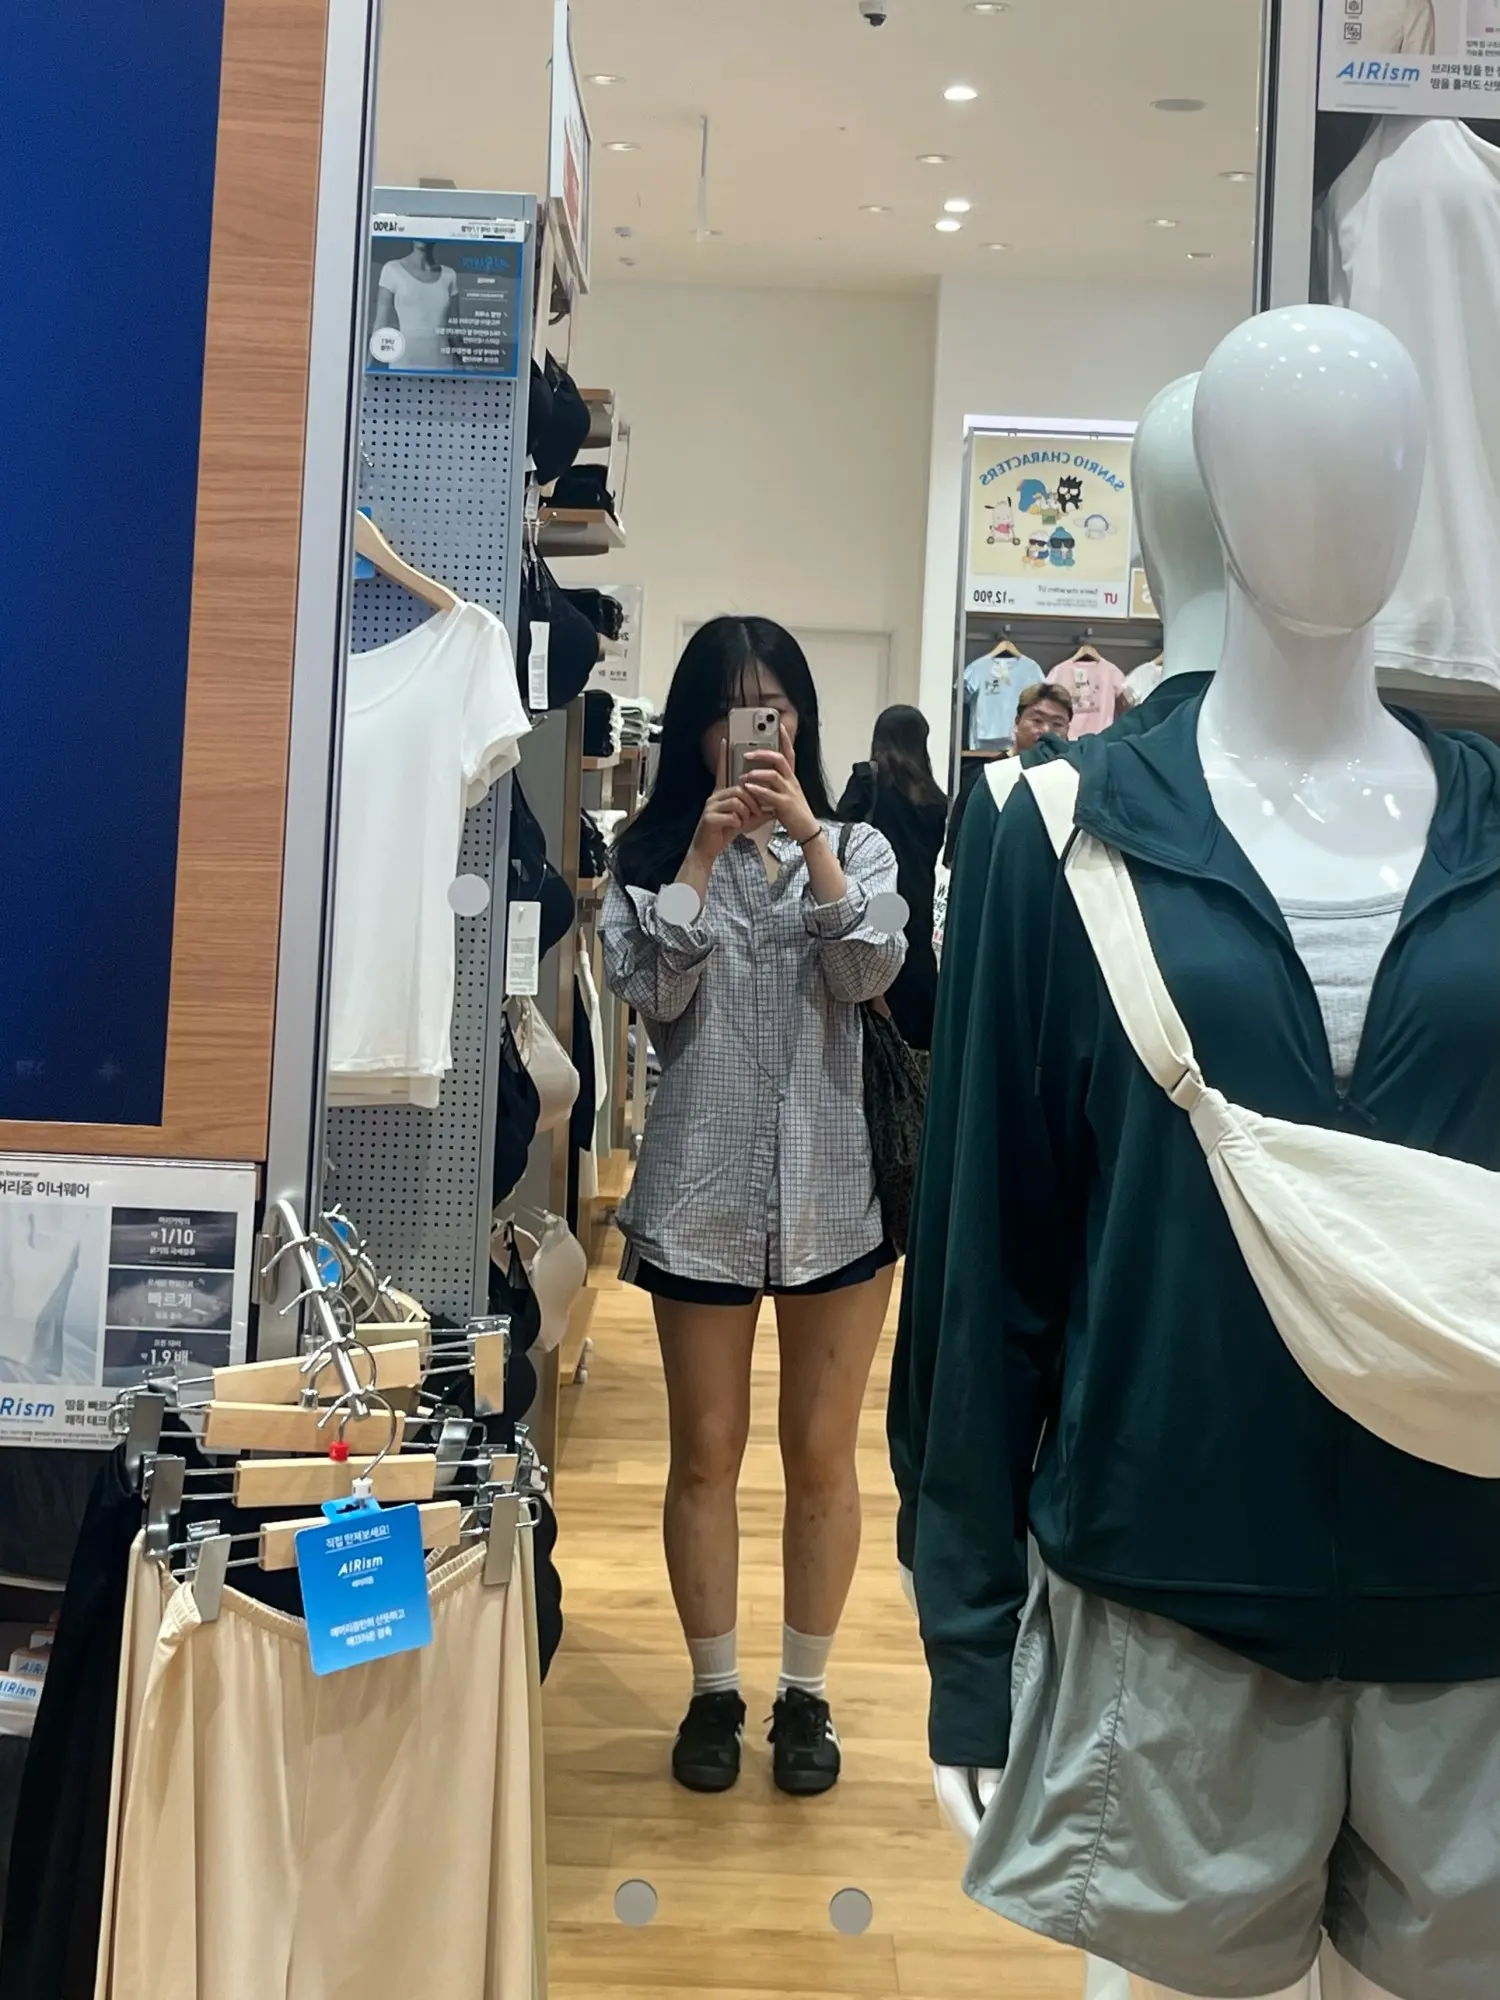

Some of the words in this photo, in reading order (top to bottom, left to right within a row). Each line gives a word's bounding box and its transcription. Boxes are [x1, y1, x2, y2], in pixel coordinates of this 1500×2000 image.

[1336, 61, 1420, 82] AIRism
[37, 1181, 90, 1199] 이너웨어
[147, 1292, 192, 1309] 빠르게
[0, 1397, 55, 1418] Rism
[88, 1400, 110, 1412] 빠르
[87, 1415, 109, 1427] 테크
[338, 1556, 383, 1577] AIRism
[20, 1661, 45, 1675] AIRi
